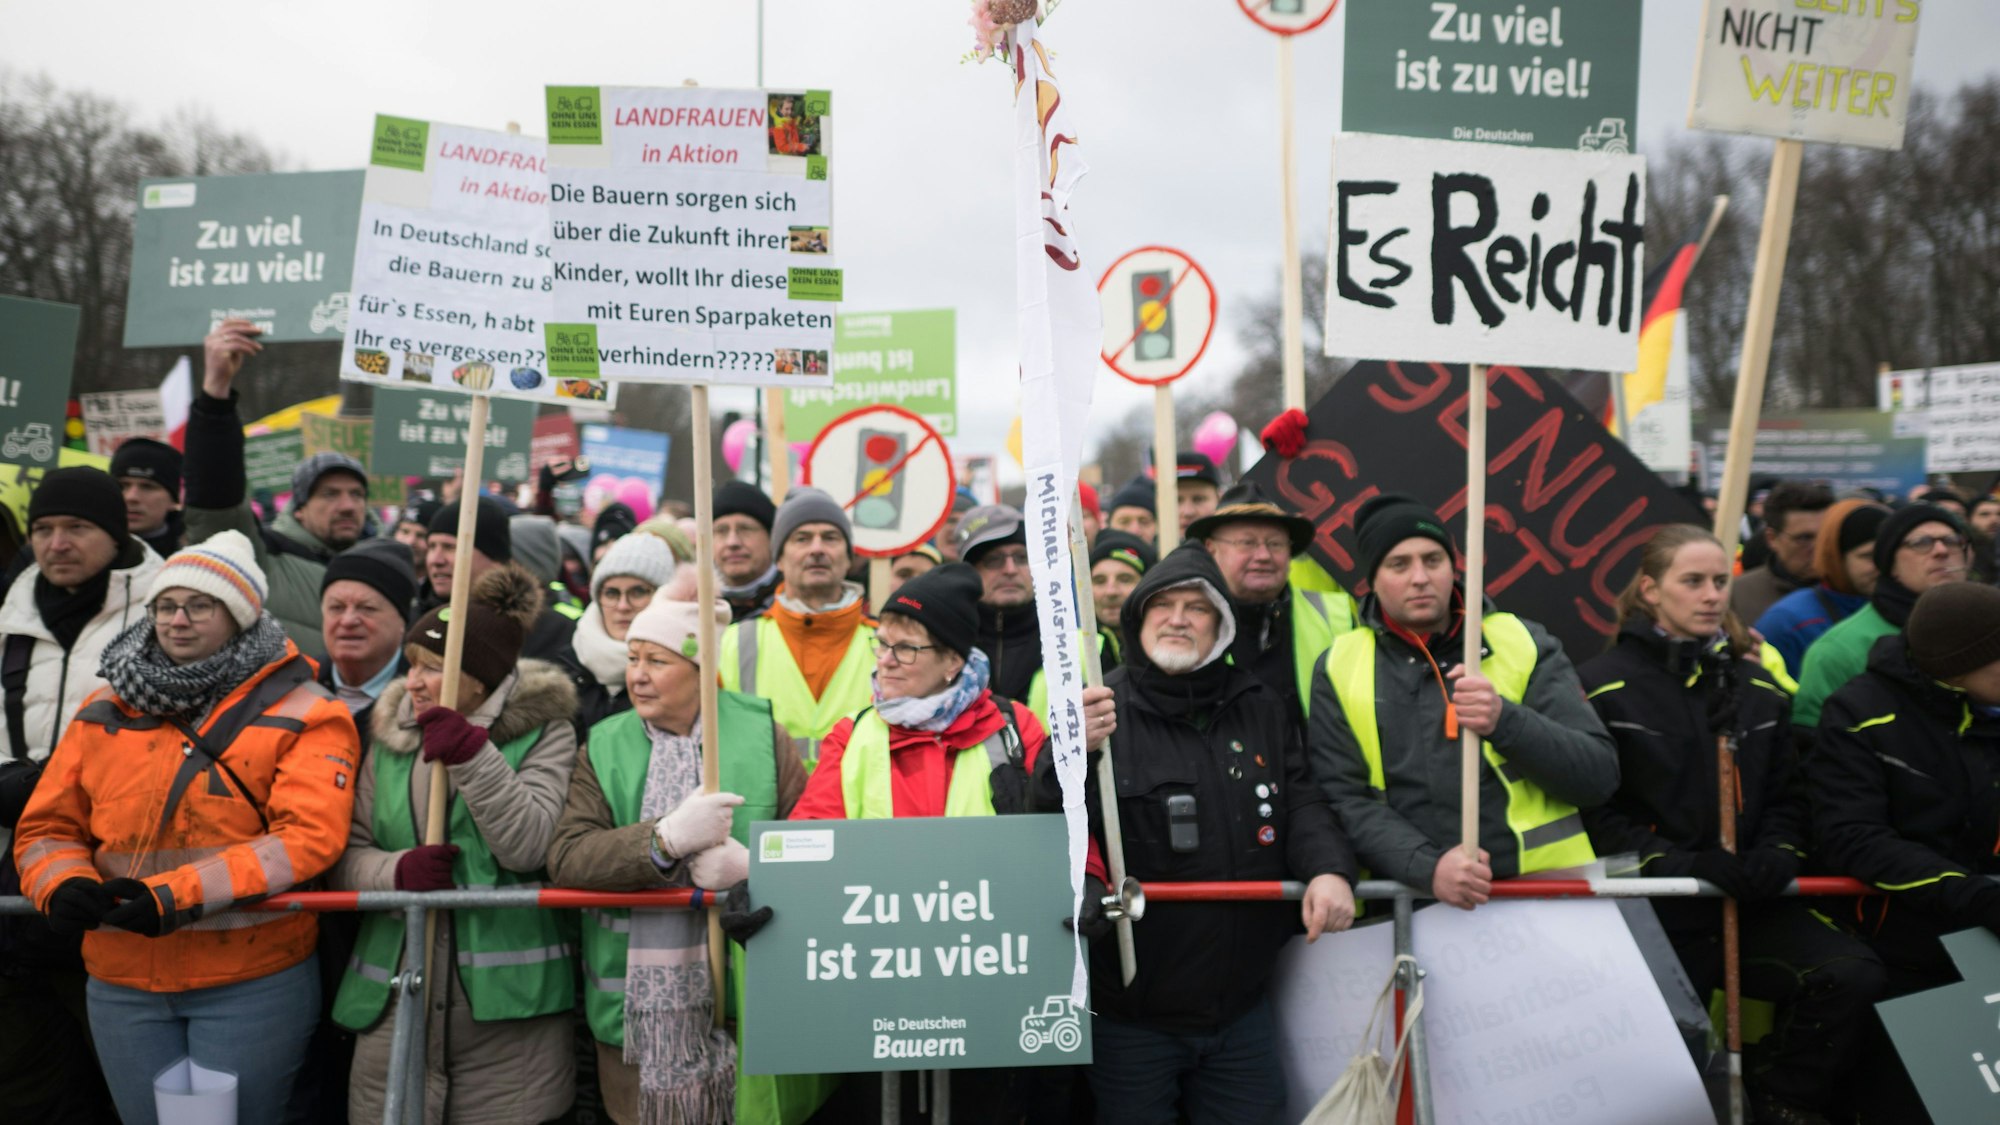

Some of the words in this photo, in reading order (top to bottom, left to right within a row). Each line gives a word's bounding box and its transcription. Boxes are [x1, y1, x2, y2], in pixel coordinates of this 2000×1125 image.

[1429, 1, 1481, 42] Zu
[1492, 4, 1563, 47] viel
[1720, 7, 1824, 55] NICHT
[1395, 49, 1442, 91] ist
[1452, 62, 1498, 93] zu
[1509, 56, 1591, 98] viel!
[1740, 54, 1897, 118] WEITER
[551, 111, 577, 120] OHNE
[579, 112, 597, 121] UNS
[551, 121, 572, 129] KEIN
[573, 121, 598, 129] ESSEN
[614, 107, 765, 127] LANDFRAUEN
[1453, 126, 1474, 140] Die
[1475, 128, 1535, 143] Deutschen
[642, 144, 661, 164] in
[667, 144, 739, 164] Aktion
[460, 176, 479, 194] in
[550, 183, 586, 203] Die
[593, 185, 669, 207] Bauern
[675, 192, 748, 212] sorgen
[755, 191, 797, 212] sich
[196, 220, 238, 250] Zu
[245, 214, 302, 247] viel
[374, 219, 392, 237] In
[400, 223, 528, 256] Deutschland
[553, 221, 602, 241] über
[609, 223, 641, 243] die
[648, 225, 730, 247] Zukunft
[737, 228, 788, 250] ihrer
[1337, 180, 1413, 309] Es
[1431, 171, 1645, 333] Reicht
[169, 256, 206, 287] ist
[212, 261, 249, 285] zu
[257, 251, 325, 284] viel!
[389, 256, 421, 275] die
[428, 261, 503, 286] Bauern
[512, 274, 534, 290] zu
[554, 262, 629, 287] Kinder,
[636, 267, 689, 287] wollt
[695, 268, 725, 287] Ihr
[731, 269, 788, 290] diese
[792, 268, 818, 276] OHNE
[820, 269, 839, 277] UNS
[792, 277, 813, 285] KEIN
[814, 277, 839, 286] ESSEN
[413, 303, 477, 329] Essen,
[587, 302, 622, 320] mit
[630, 303, 690, 324] Euren
[695, 306, 833, 330] Sparpaketen
[354, 329, 383, 347] Ihr
[390, 338, 412, 352] es
[551, 346, 574, 355] OHNE
[576, 347, 594, 356] UNS
[551, 355, 571, 363] KEIN
[573, 356, 595, 364] ESSEN
[598, 346, 776, 373] verhindern?????
[843, 886, 900, 925] Zu
[912, 880, 994, 922] viel
[806, 938, 857, 981] ist
[870, 948, 922, 979] zu
[934, 933, 1029, 977] viel!
[873, 1019, 896, 1031] Die
[898, 1017, 967, 1031] Deutschen
[873, 1035, 967, 1059] Bauern
